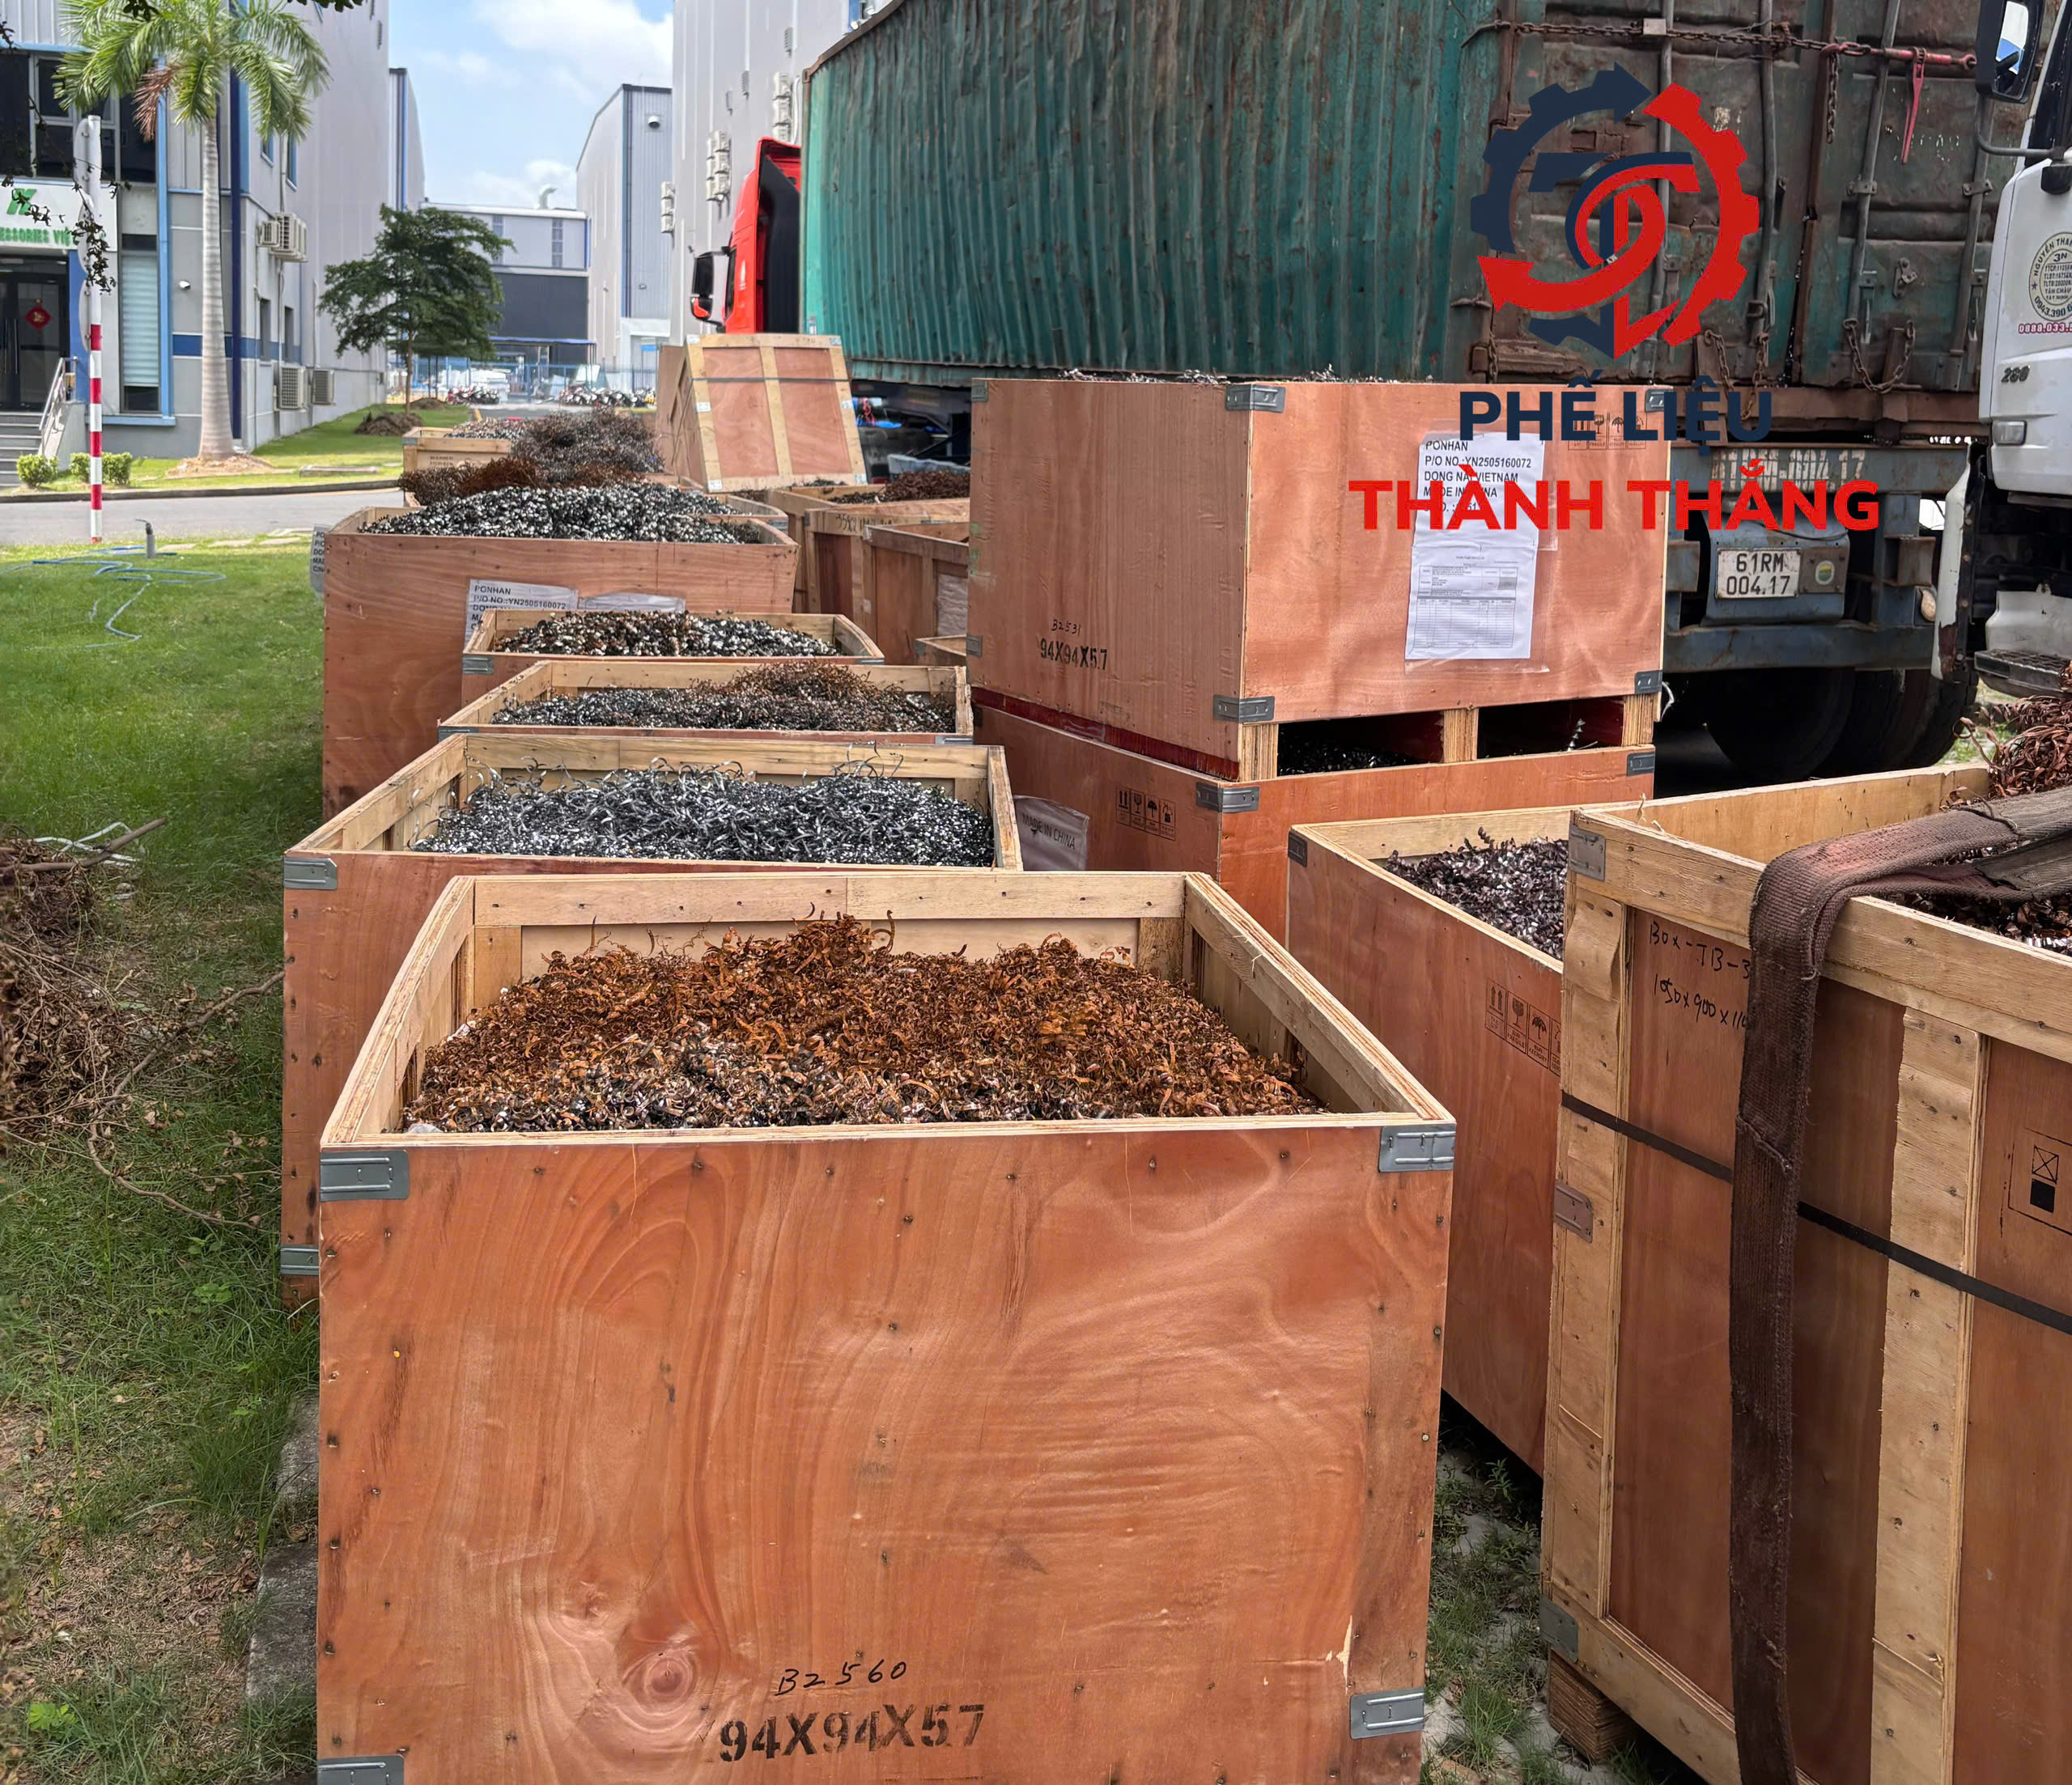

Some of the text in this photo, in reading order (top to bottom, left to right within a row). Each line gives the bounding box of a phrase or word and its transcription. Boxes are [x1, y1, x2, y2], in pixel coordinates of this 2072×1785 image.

[1424, 471, 1453, 481] DONG
[1475, 472, 1518, 483] VIETNAM
[1736, 553, 1784, 572] 61RM
[474, 585, 511, 595] PONHAN
[1726, 575, 1790, 596] 004.17
[1054, 828, 1076, 850] CHINA
[720, 1703, 985, 1762] 94X94X57
